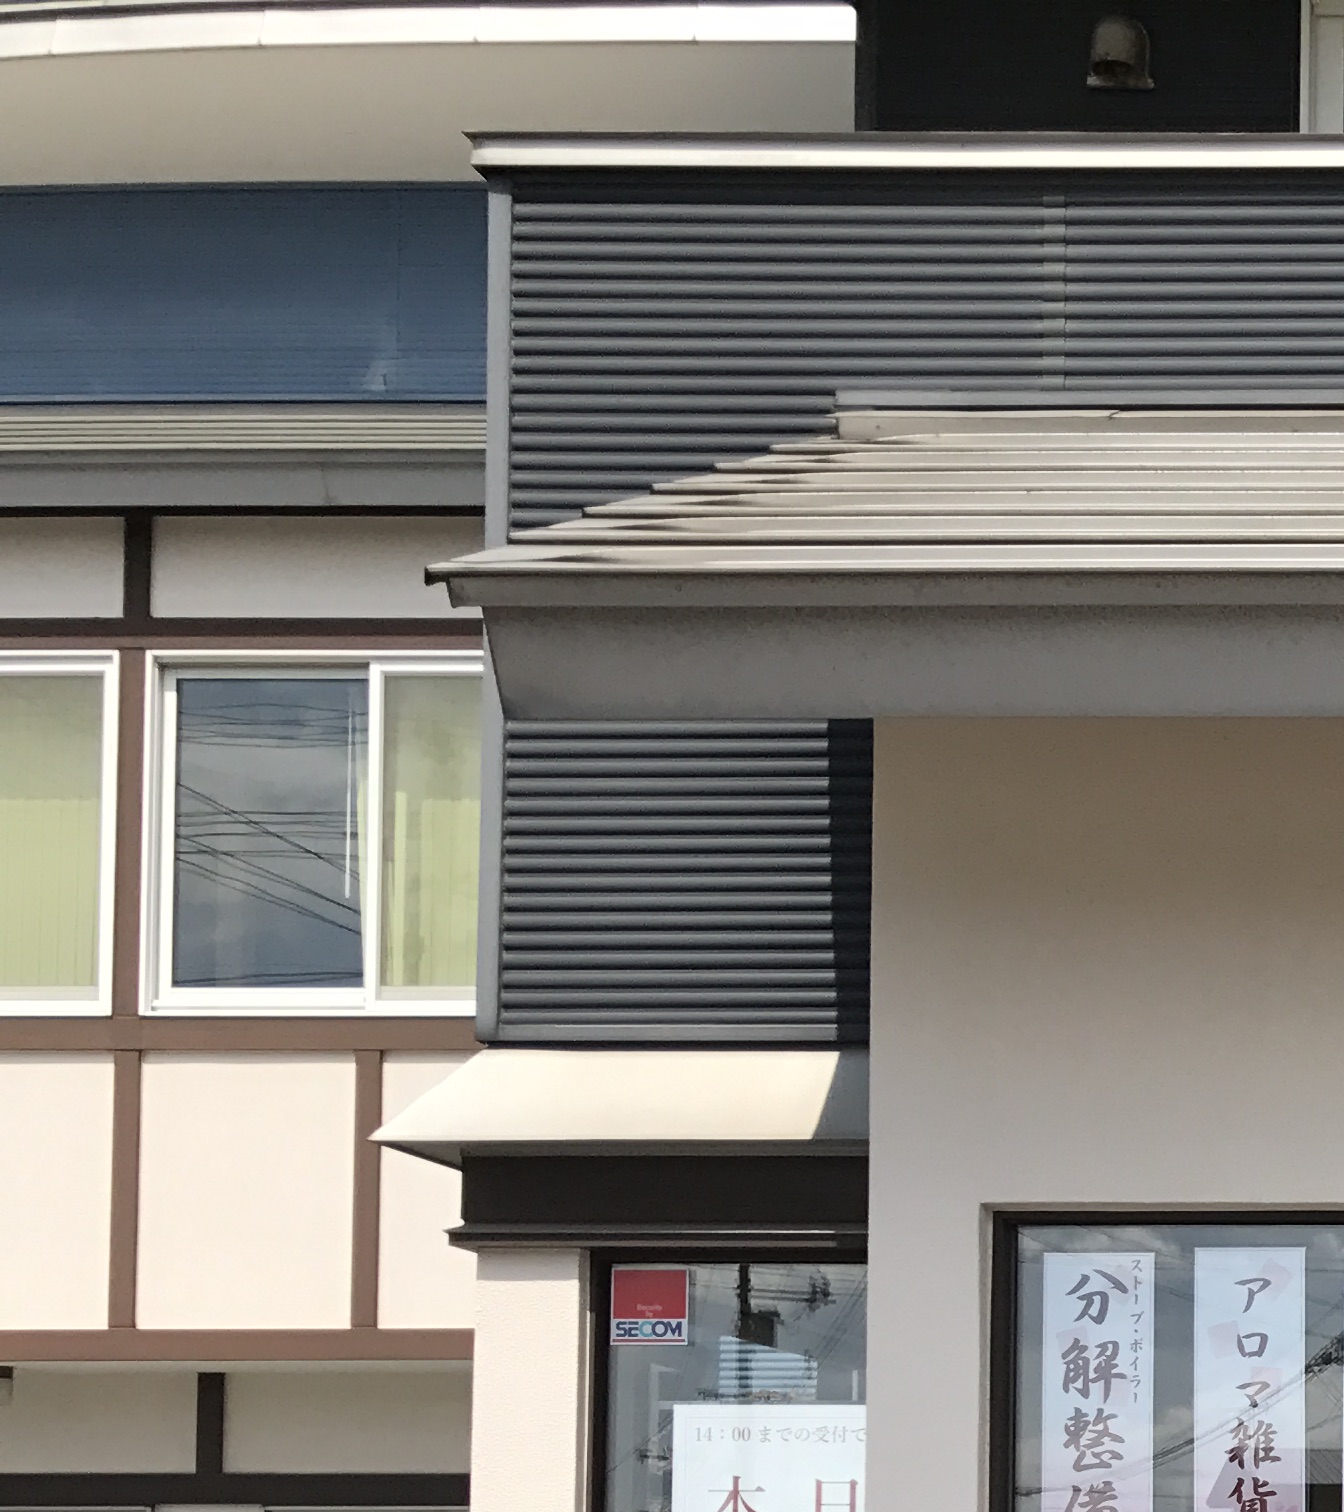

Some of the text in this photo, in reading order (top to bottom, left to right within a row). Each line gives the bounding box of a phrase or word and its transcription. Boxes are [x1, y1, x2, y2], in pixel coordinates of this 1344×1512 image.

[615, 1321, 682, 1338] SECOM
[1129, 1259, 1145, 1404] ストーブ・ボイラー
